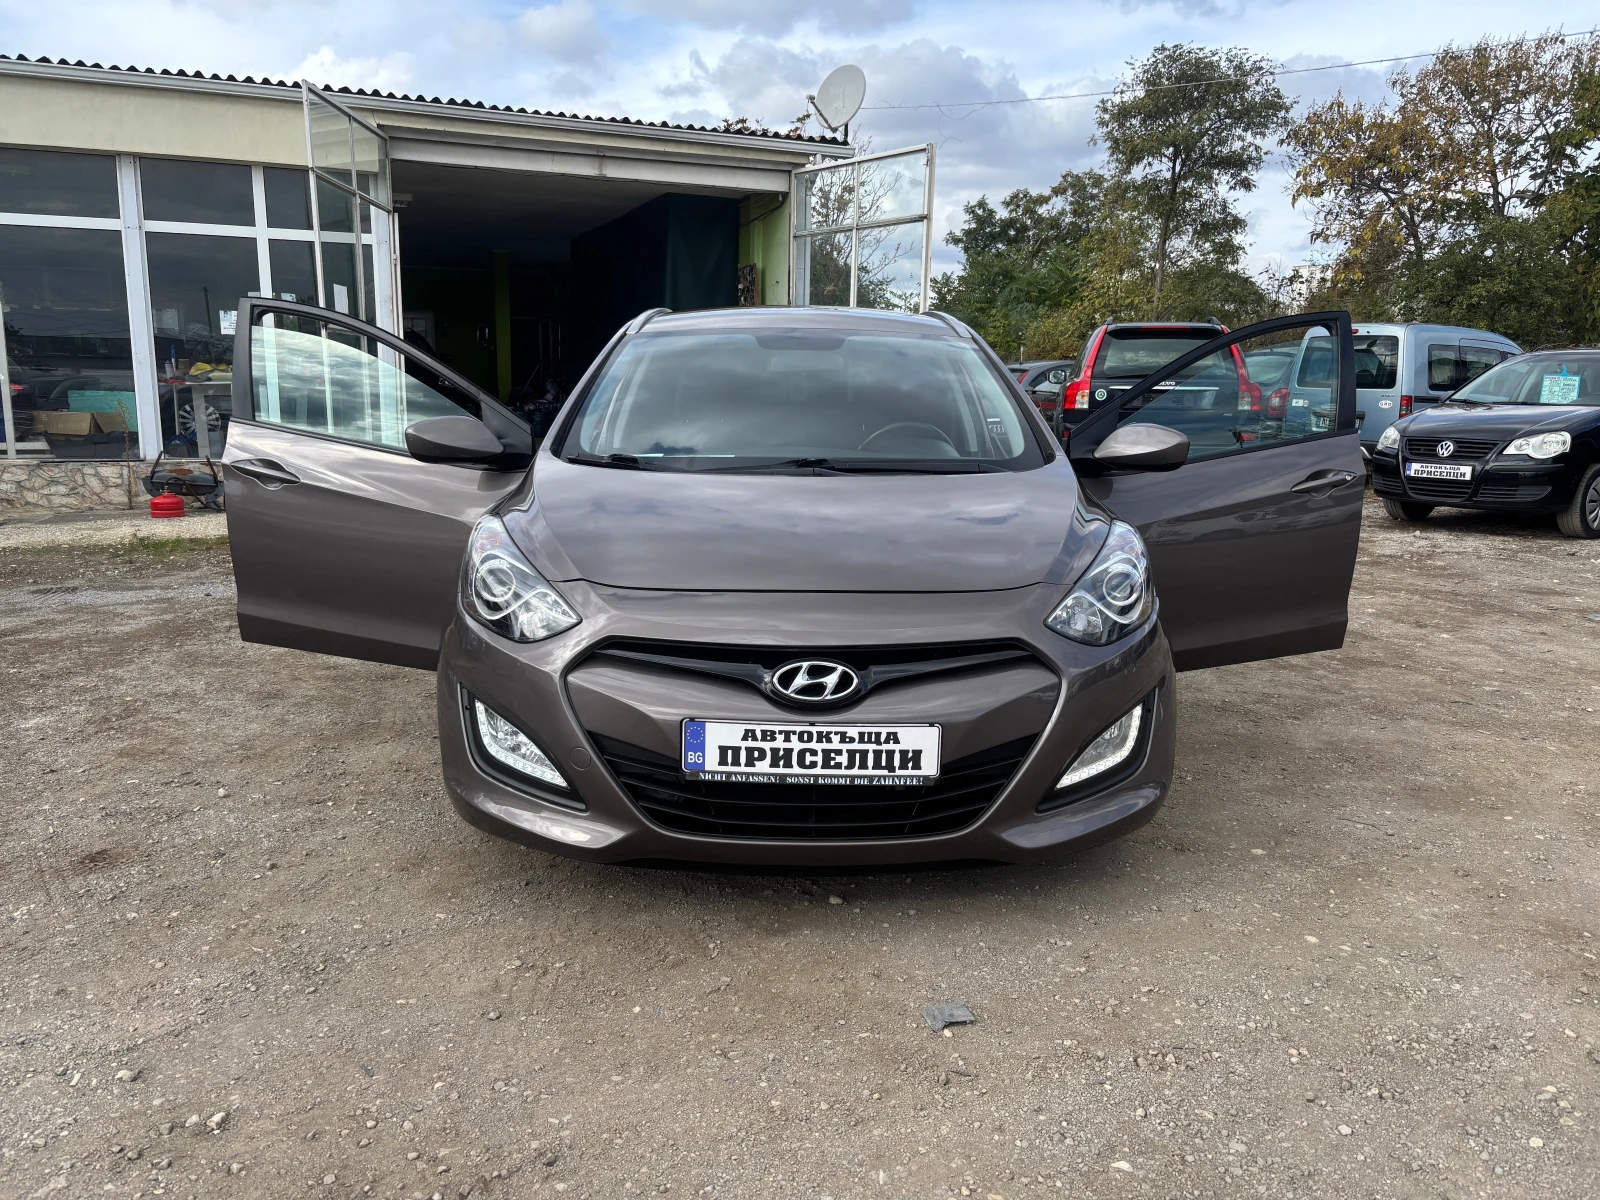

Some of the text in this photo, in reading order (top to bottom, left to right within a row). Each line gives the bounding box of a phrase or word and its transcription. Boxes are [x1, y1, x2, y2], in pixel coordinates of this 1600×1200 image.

[1413, 469, 1467, 480] ПРИСЕЛЦИ
[740, 728, 901, 746] АВТОКЪЩА
[687, 751, 703, 763] BG
[717, 745, 923, 773] ПРИСЕЛЦИ
[698, 772, 923, 785] NICHT ANFASSEN! SONST KOMMT DIE ZAHNFEE!
